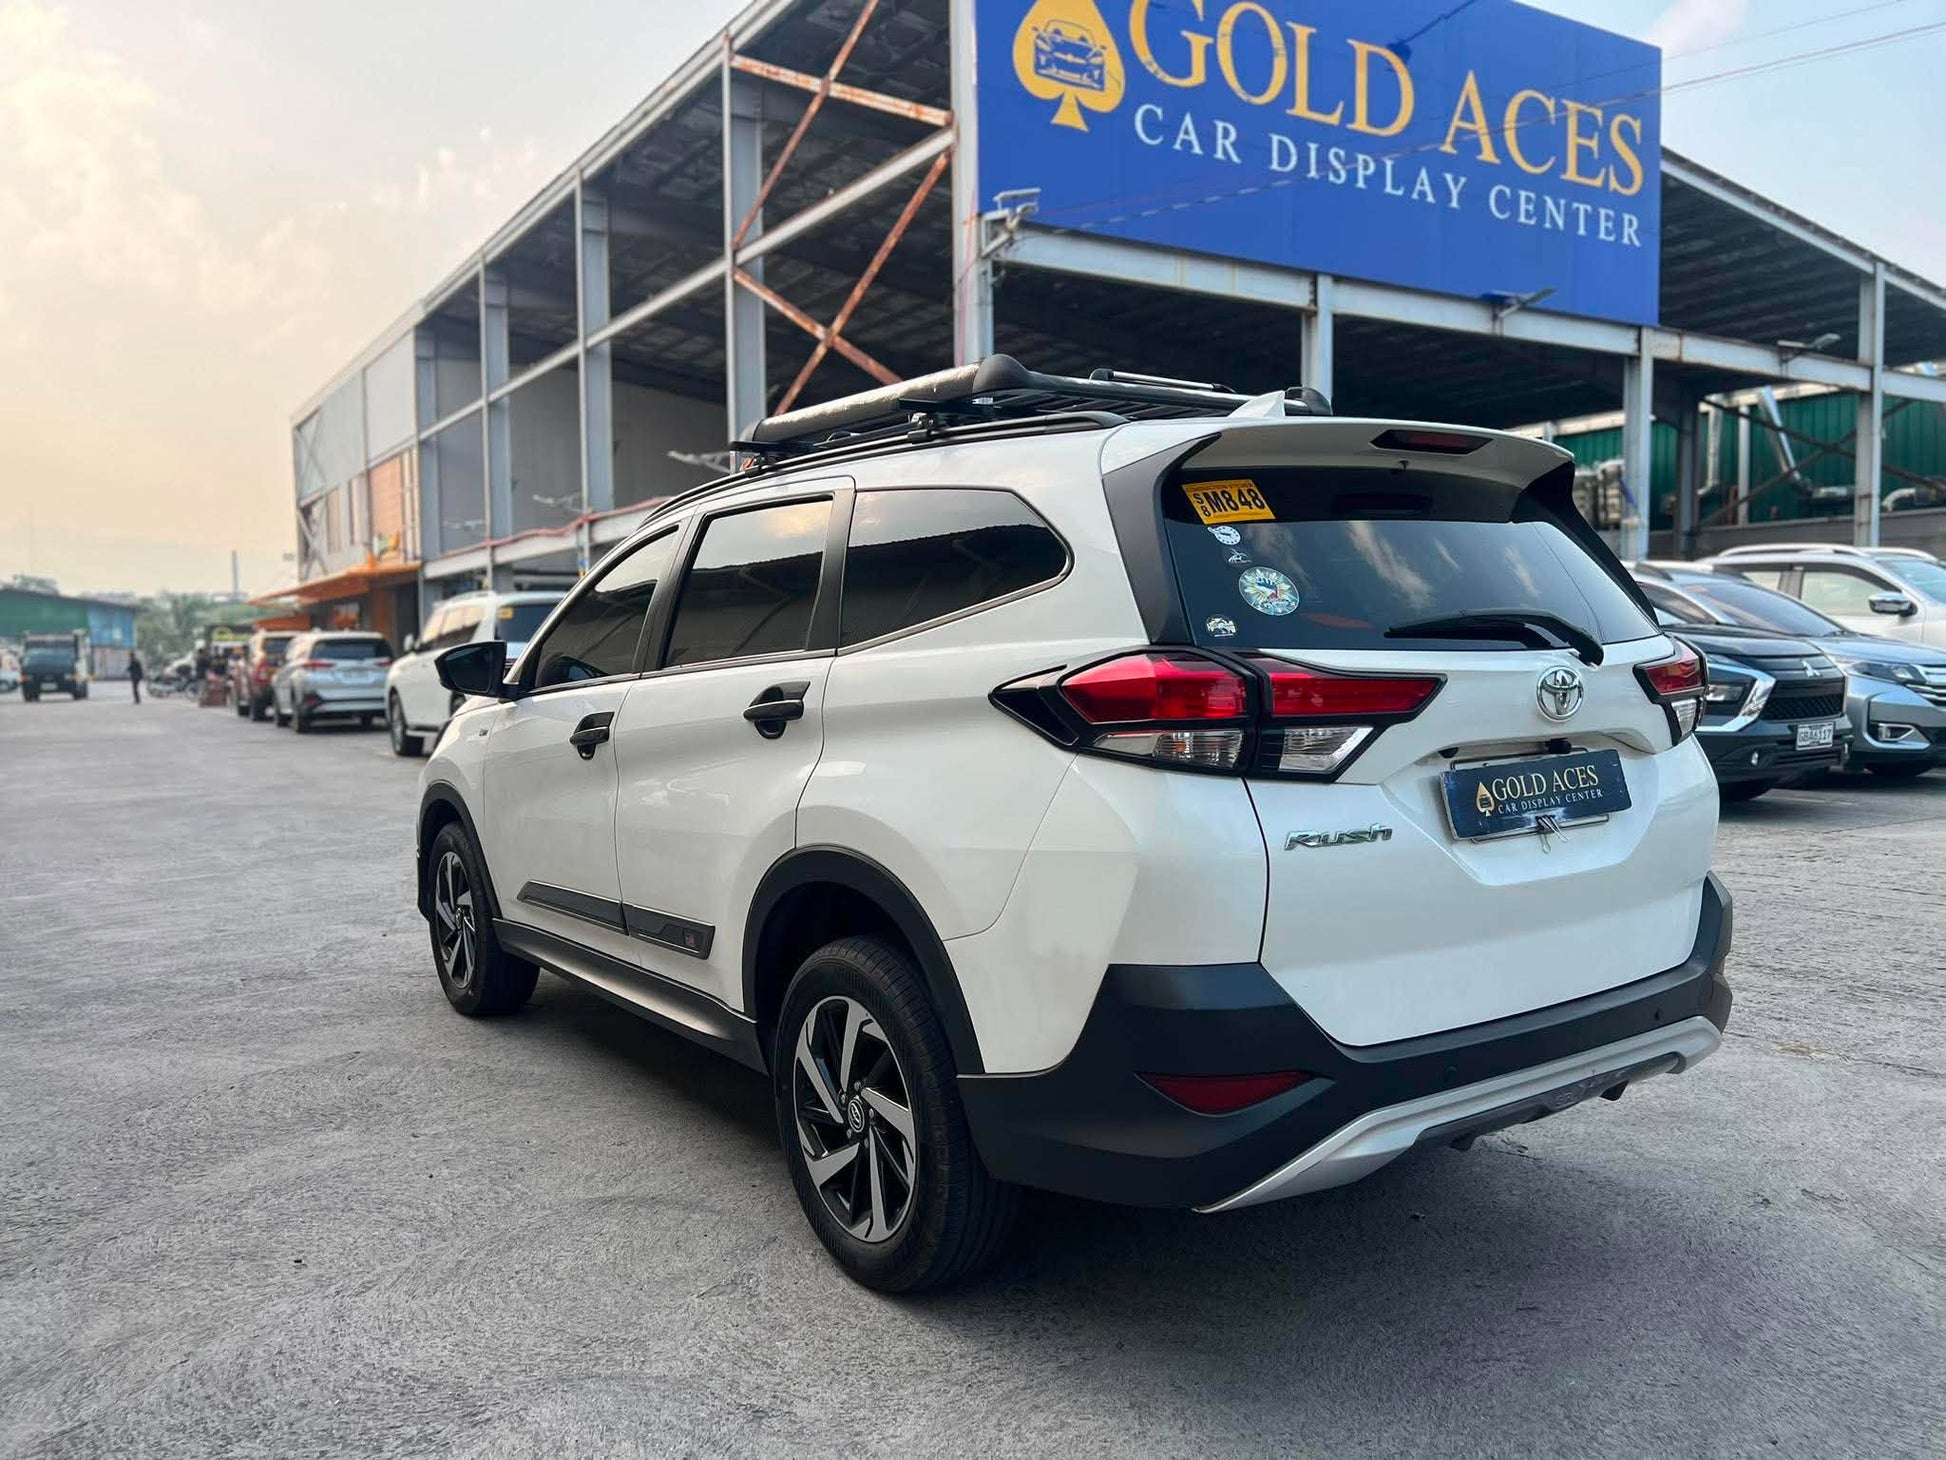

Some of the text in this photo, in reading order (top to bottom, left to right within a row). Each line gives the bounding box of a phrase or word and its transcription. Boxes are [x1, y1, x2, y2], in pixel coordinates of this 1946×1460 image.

[1129, 0, 1644, 196] GOLD ACES
[1134, 103, 1642, 248] CAR DISPLAY CENTER
[1202, 488, 1265, 513] M848
[1492, 765, 1599, 801] GOLD ACES
[1498, 789, 1604, 815] CAR DISPLAY CENTER
[1284, 823, 1393, 851] Rush
